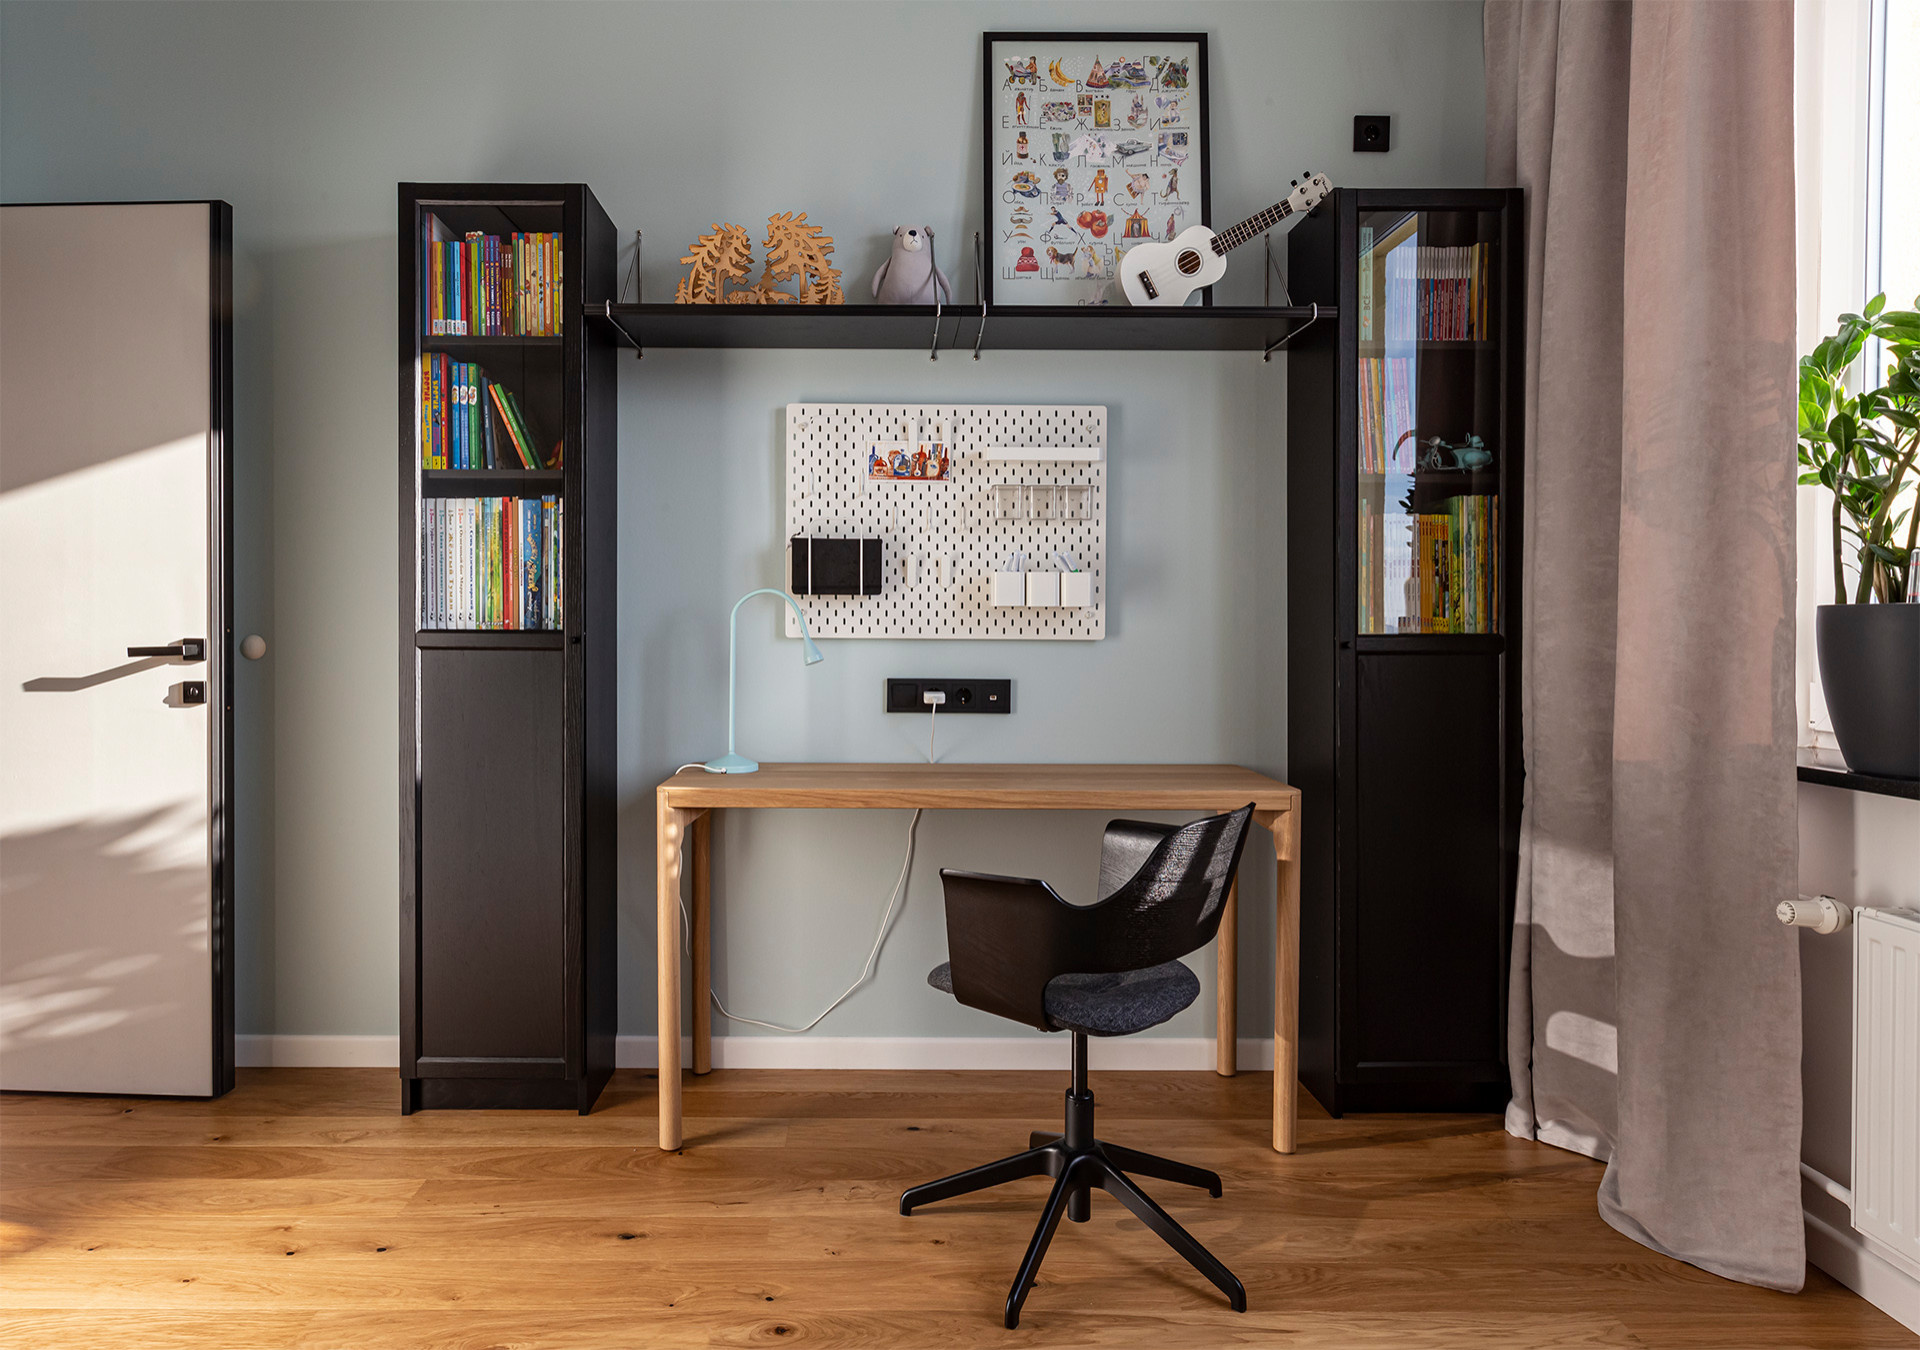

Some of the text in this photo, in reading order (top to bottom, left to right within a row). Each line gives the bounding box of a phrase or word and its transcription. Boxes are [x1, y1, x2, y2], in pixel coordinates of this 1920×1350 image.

[1002, 79, 1012, 91] А
[1039, 79, 1048, 92] Б
[1076, 79, 1084, 92] В
[1149, 78, 1159, 93] Д
[1002, 116, 1009, 128] Е
[1074, 118, 1088, 130] Ж
[1150, 118, 1160, 130] И
[1002, 150, 1013, 166] Й
[1040, 153, 1046, 166] К
[1113, 156, 1124, 168] М
[1150, 155, 1158, 167] Н
[1003, 190, 1015, 204] О
[1040, 192, 1048, 204] П
[1077, 193, 1084, 205] Р
[1113, 193, 1124, 206] С
[1151, 192, 1158, 205] Т
[1002, 230, 1013, 243] У
[1040, 232, 1051, 244] Ф
[1078, 232, 1086, 245] Х
[1114, 232, 1123, 247] Ц
[1104, 244, 1113, 254] Ъ
[1104, 255, 1113, 266] Ы
[1003, 267, 1016, 279] Ш
[1040, 267, 1054, 282] Щ
[1106, 267, 1114, 277] Ь
